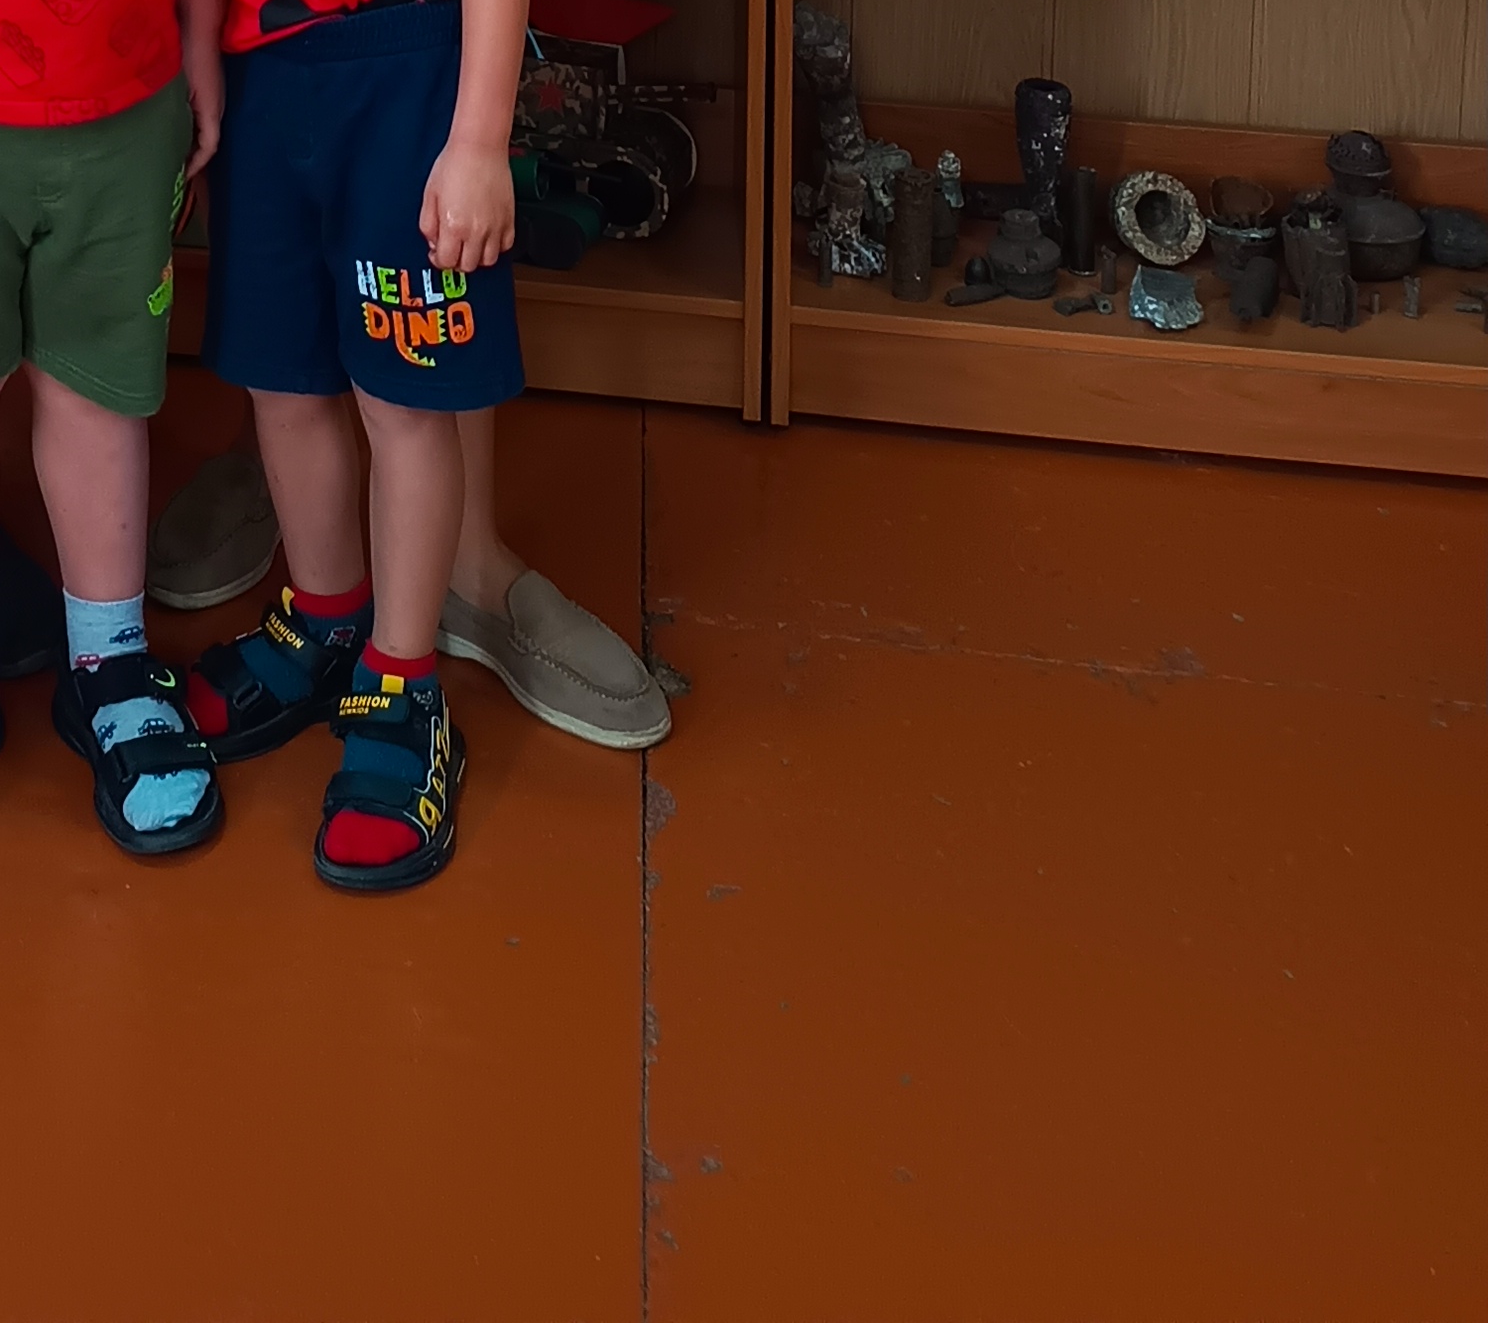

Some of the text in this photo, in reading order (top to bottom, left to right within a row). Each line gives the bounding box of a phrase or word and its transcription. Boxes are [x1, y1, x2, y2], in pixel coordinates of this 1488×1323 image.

[356, 260, 467, 307] HELLO
[361, 301, 474, 367] DINO
[269, 612, 305, 649] FASHION
[340, 695, 391, 708] FASHION
